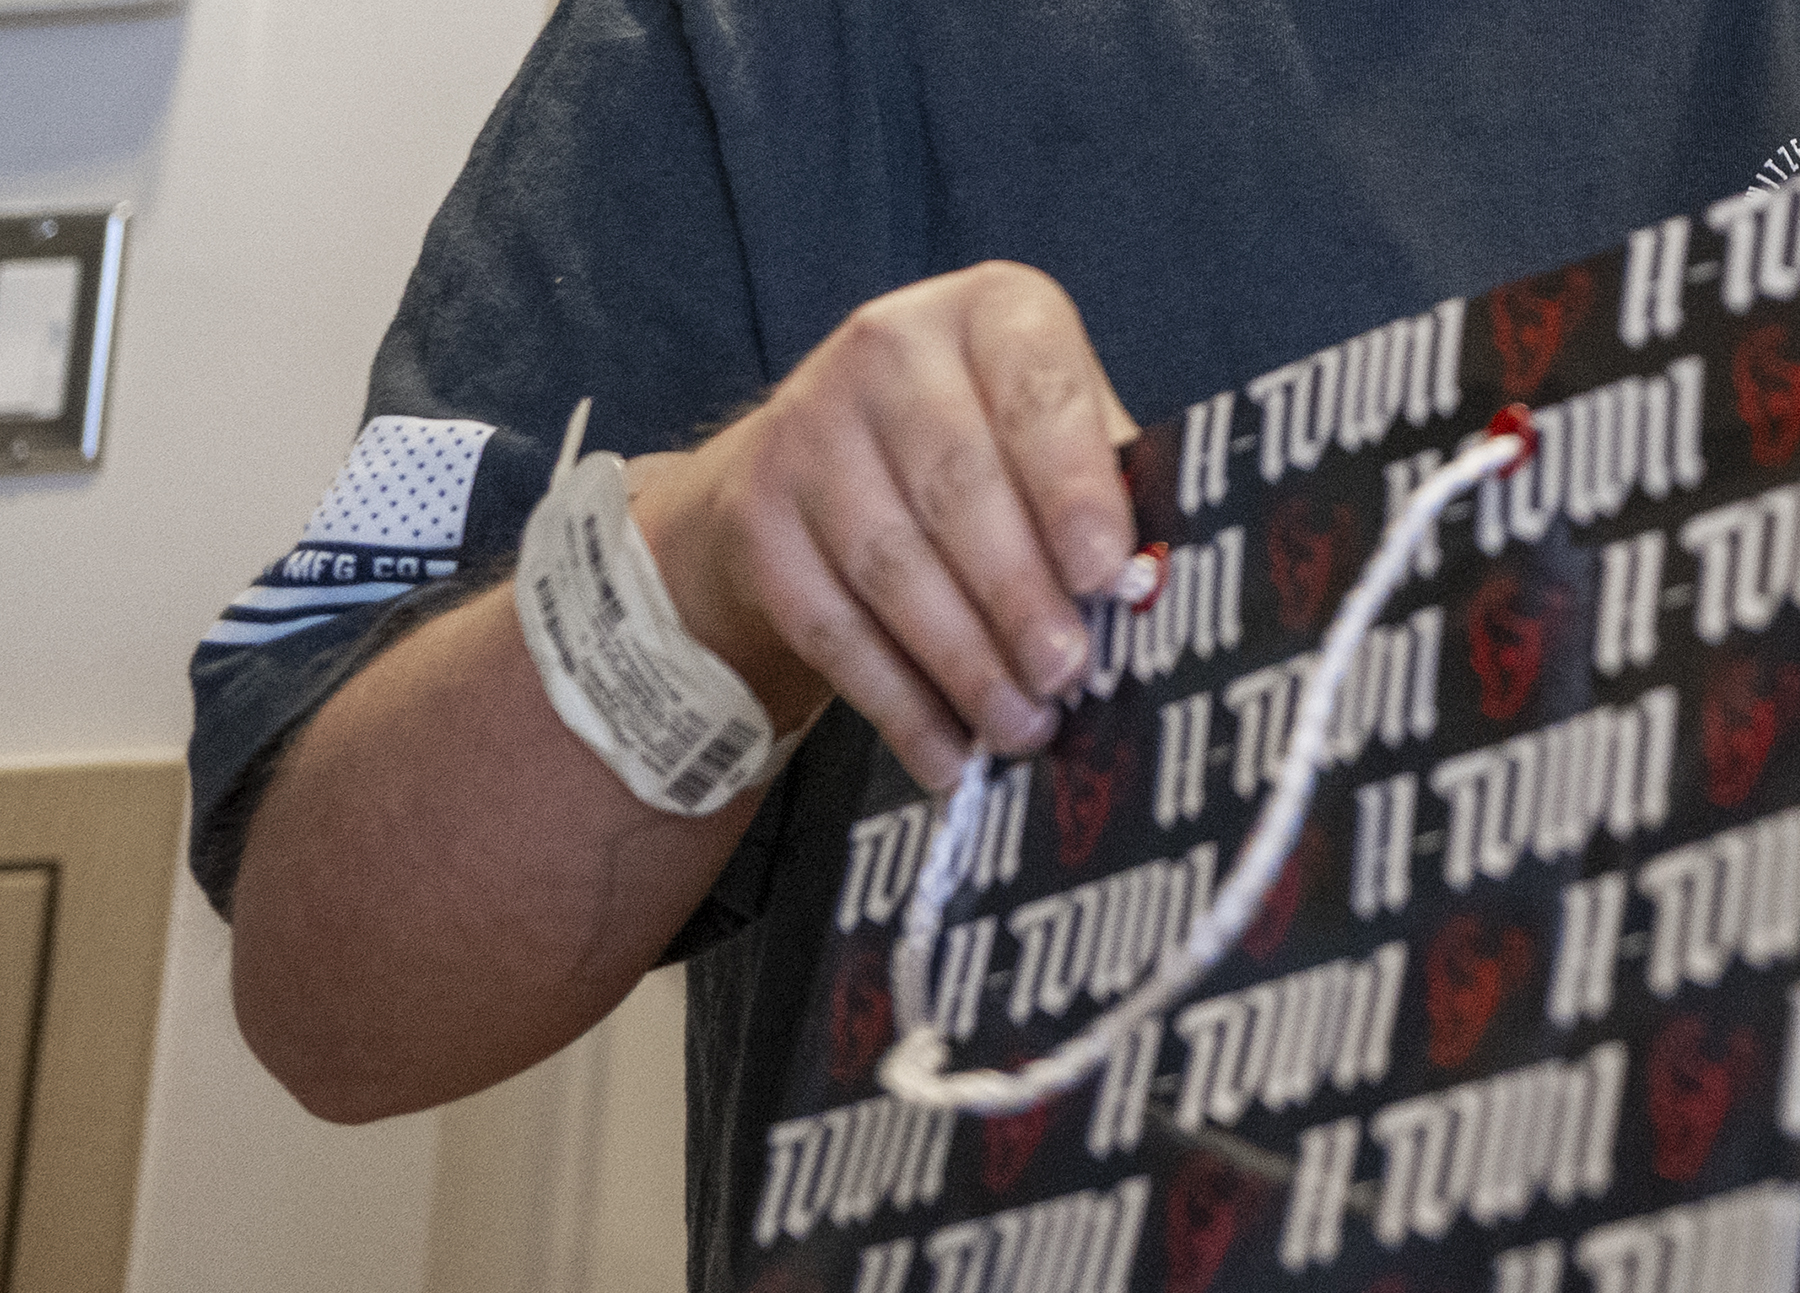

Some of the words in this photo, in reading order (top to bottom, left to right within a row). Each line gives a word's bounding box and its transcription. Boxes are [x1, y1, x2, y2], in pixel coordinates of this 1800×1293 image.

[1178, 296, 1467, 515] H-TOWN
[282, 549, 358, 581] MFG
[1350, 682, 1679, 922] H-TOWN
[1279, 1038, 1630, 1275] H-TOWN
